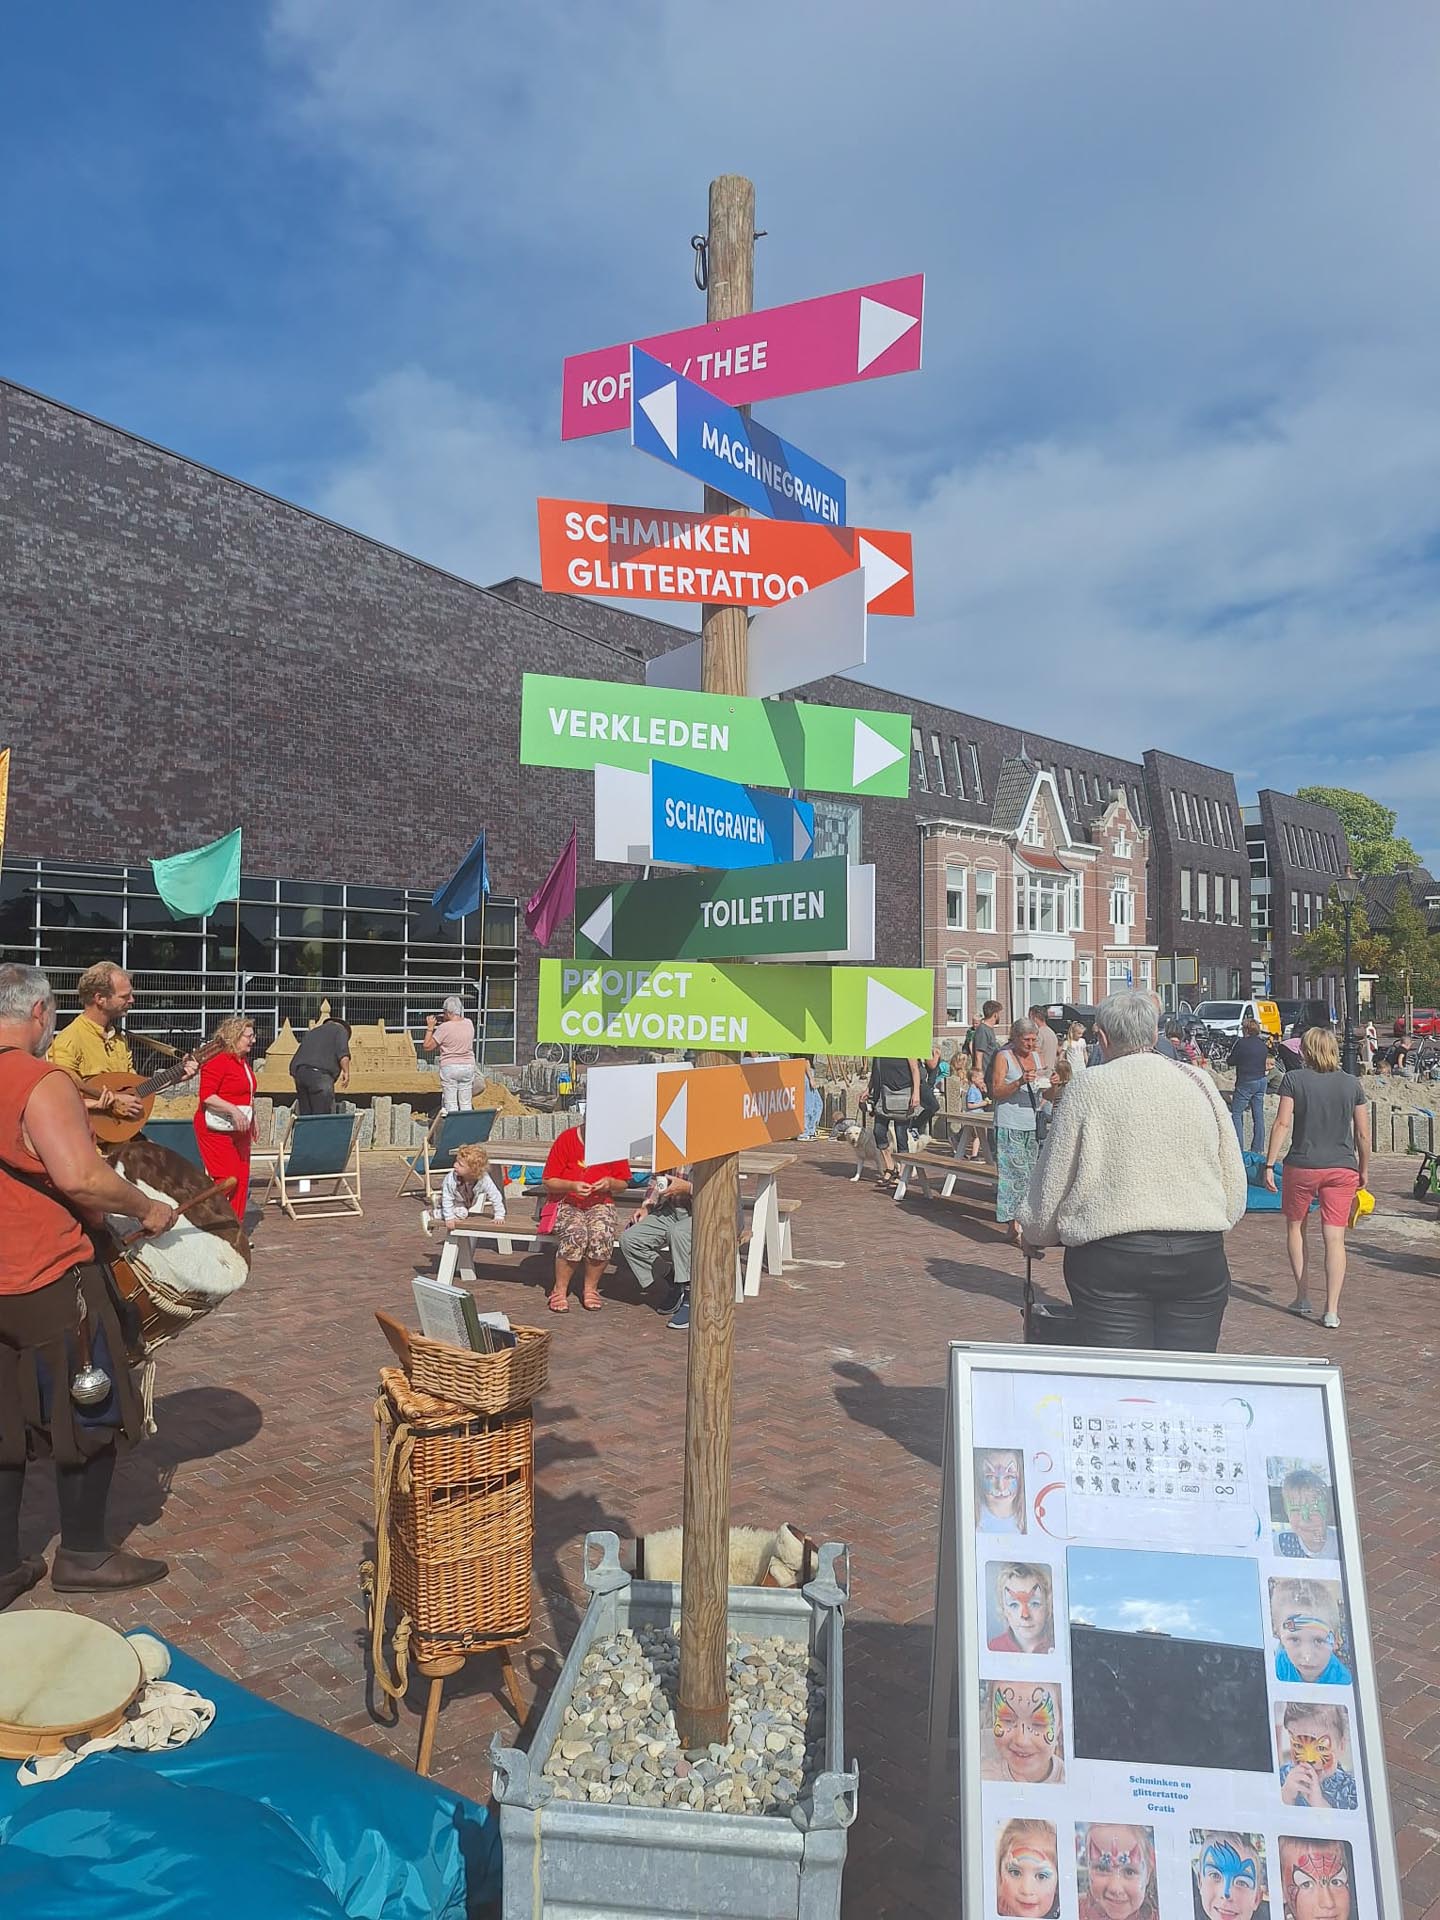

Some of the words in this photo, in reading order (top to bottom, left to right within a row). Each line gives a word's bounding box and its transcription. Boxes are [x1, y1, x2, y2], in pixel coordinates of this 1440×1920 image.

[697, 340, 768, 382] THEE
[702, 421, 839, 525] MACHINEGRAVEN
[565, 512, 750, 555] SCHMINKEN
[568, 558, 809, 601] GLITTERTATTOO
[549, 707, 729, 752] VERKLEDEN
[665, 798, 765, 844] SCHATGRAVEN
[701, 890, 825, 928] TOILETTEN
[563, 969, 692, 1004] PROJECT
[561, 1011, 748, 1043] COEVORDEN
[743, 1087, 796, 1123] RANJAKOE
[1129, 1776, 1179, 1787] Schminken
[1133, 1788, 1188, 1800] glittertattoo
[1147, 1803, 1175, 1813] Gratis
